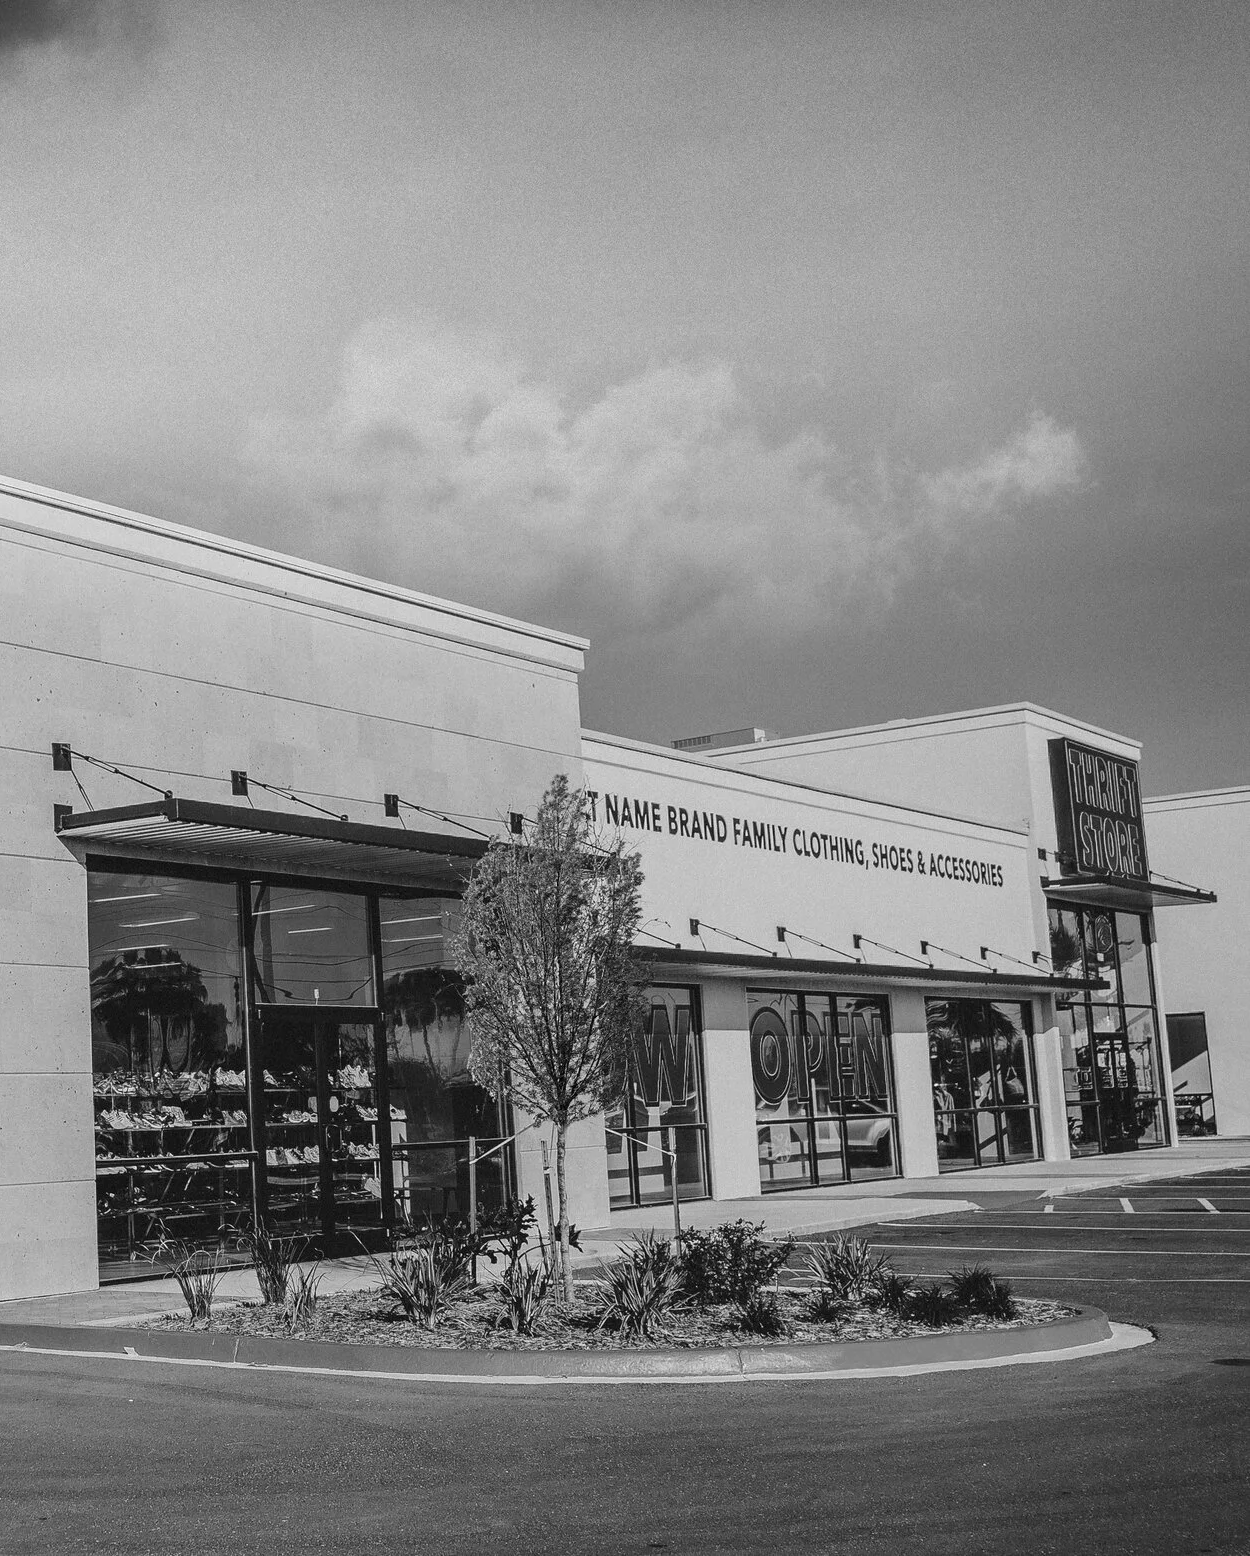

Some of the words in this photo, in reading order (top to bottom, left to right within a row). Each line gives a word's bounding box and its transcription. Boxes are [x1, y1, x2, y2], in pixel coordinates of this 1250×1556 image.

[1068, 748, 1137, 818] THRIFT
[605, 793, 662, 832] NAME
[668, 805, 727, 843] BRAND
[733, 818, 788, 853] FAMILY
[793, 828, 869, 870] CLOTHING,
[872, 842, 914, 873] SHOES
[917, 850, 926, 875] &
[929, 853, 1004, 887] ACCESSORIES
[1079, 811, 1143, 876] STORE
[750, 1006, 889, 1106] OPEN
